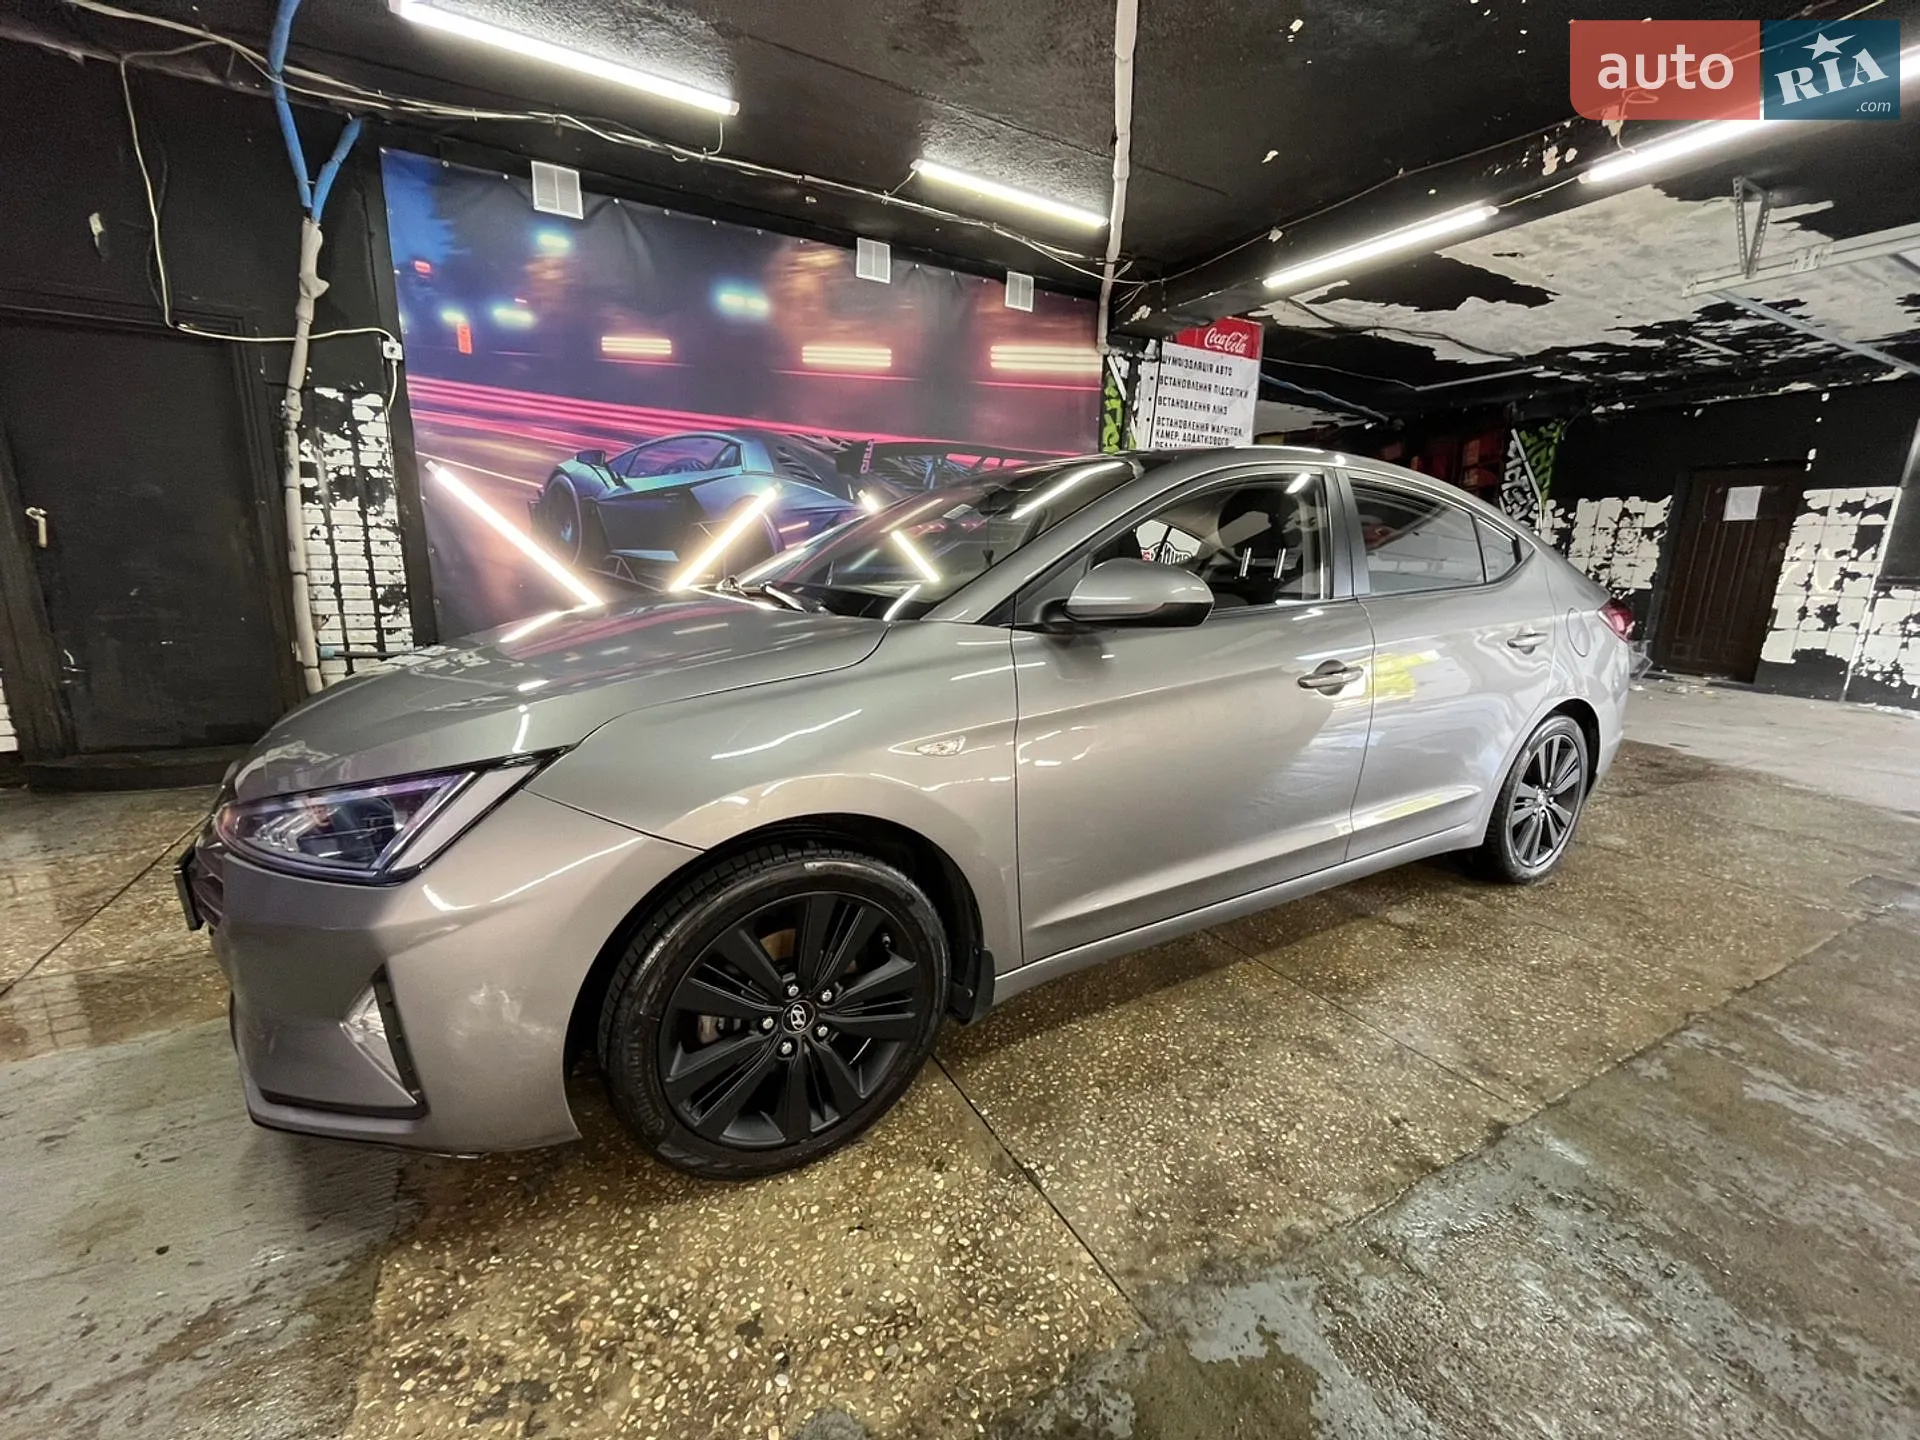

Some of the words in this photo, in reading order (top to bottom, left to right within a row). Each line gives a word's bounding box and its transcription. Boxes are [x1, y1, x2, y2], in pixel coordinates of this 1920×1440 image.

[1215, 364, 1232, 376] АВТО
[1159, 375, 1212, 392] ВСТАНОВЛЕННЯ
[1157, 396, 1211, 412] ВСТАНОВЛЕННЯ
[1156, 416, 1209, 433] ВСТАНОВЛЕННЯ
